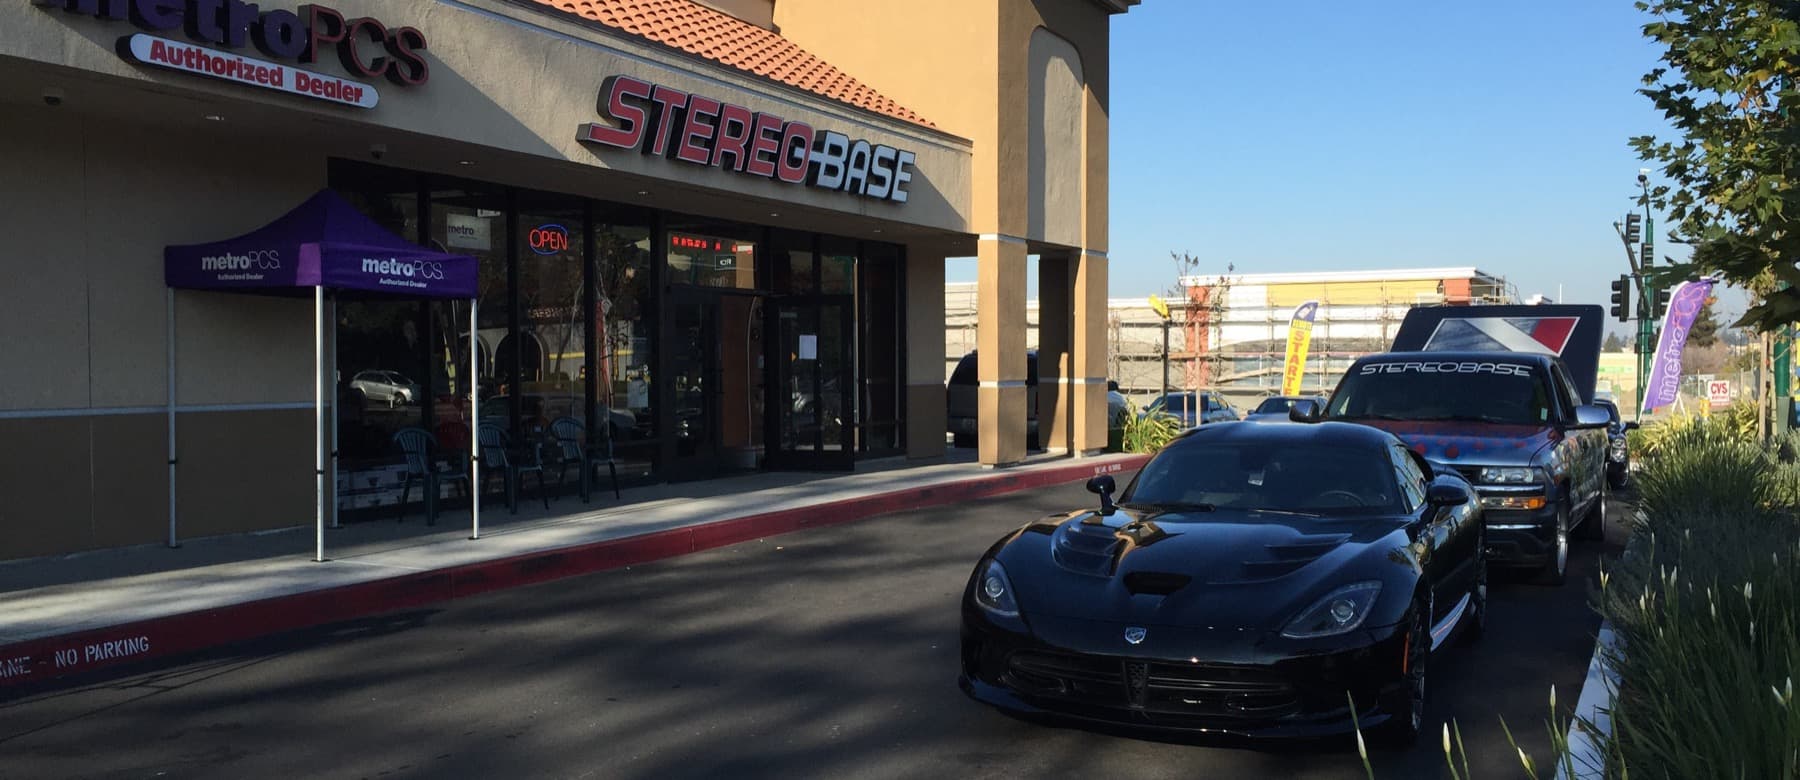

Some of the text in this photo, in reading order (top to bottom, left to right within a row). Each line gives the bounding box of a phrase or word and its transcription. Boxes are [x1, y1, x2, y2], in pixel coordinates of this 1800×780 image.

[150, 39, 364, 104] Authorized Dealer
[528, 228, 569, 251] OPEN
[201, 249, 281, 271] metroPCS
[362, 257, 445, 281] metroPCS
[1359, 361, 1534, 378] STEREOBASE
[1710, 382, 1728, 395] CVS
[55, 647, 78, 668] NO
[85, 636, 150, 663] PARKING
